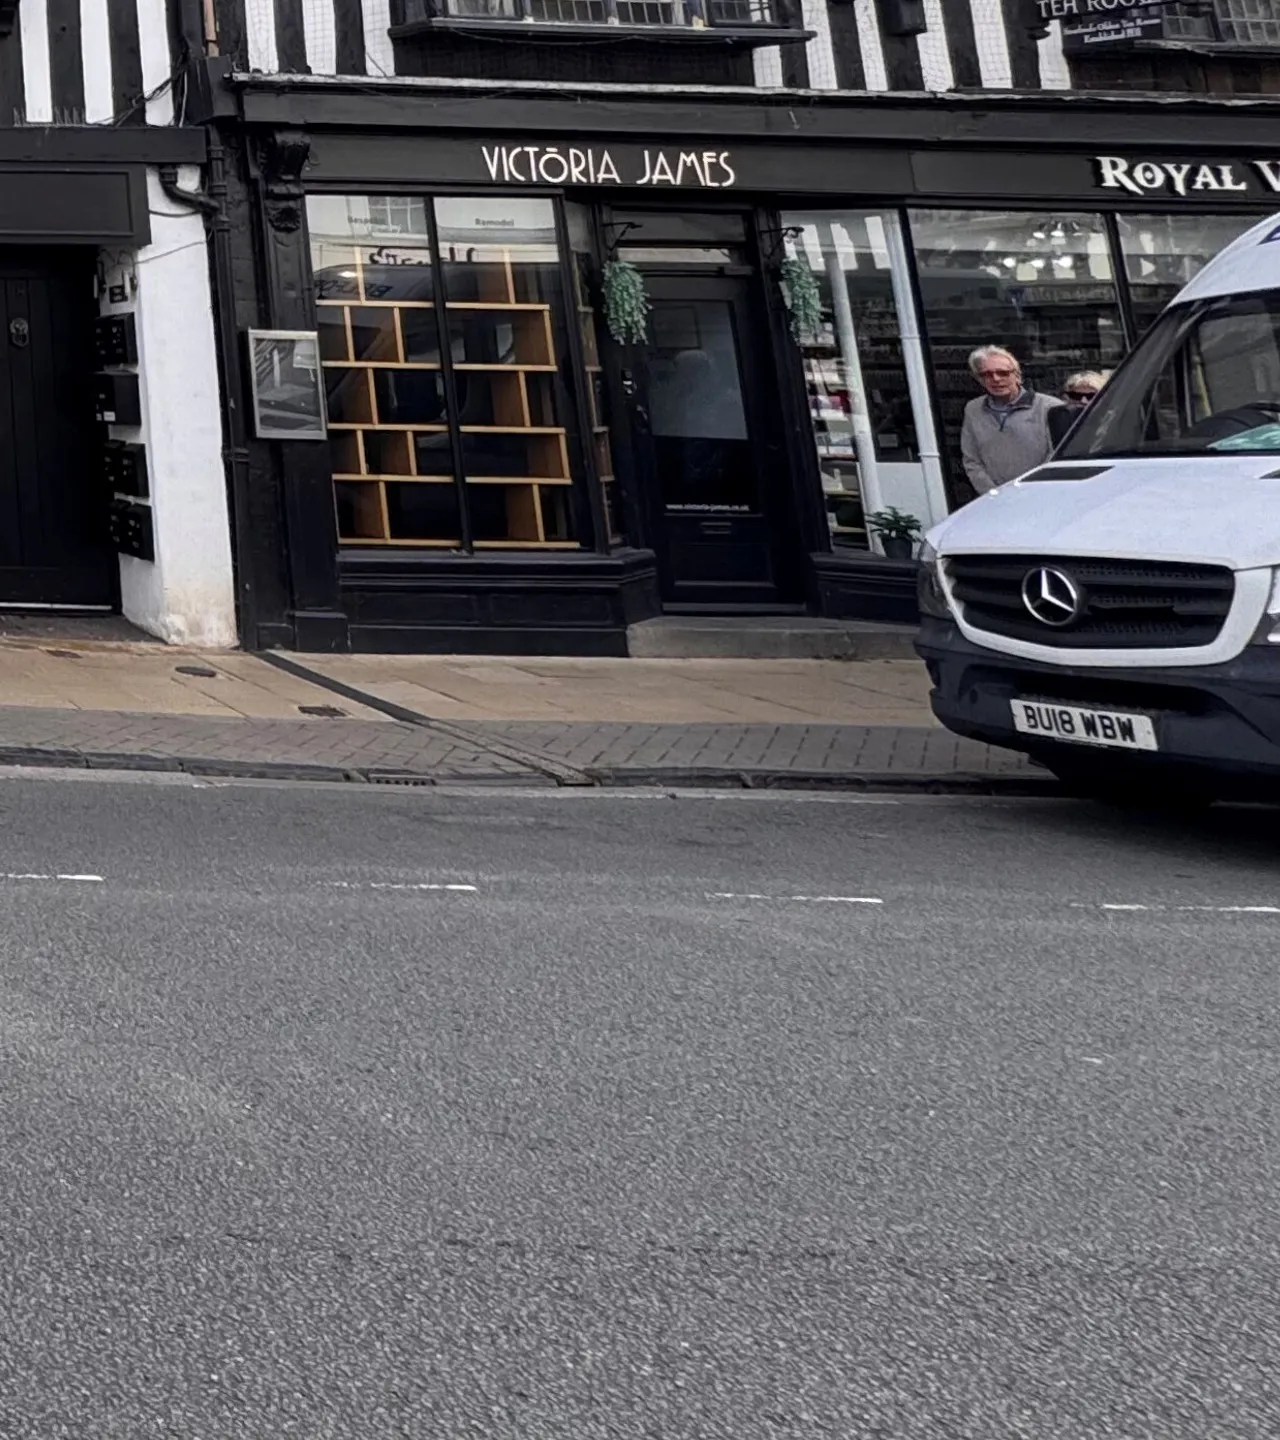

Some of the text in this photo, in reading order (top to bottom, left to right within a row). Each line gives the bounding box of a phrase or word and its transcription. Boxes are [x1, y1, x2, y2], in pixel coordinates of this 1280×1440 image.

[636, 149, 736, 188] JAMES
[1023, 705, 1136, 743] BU18 WBW
